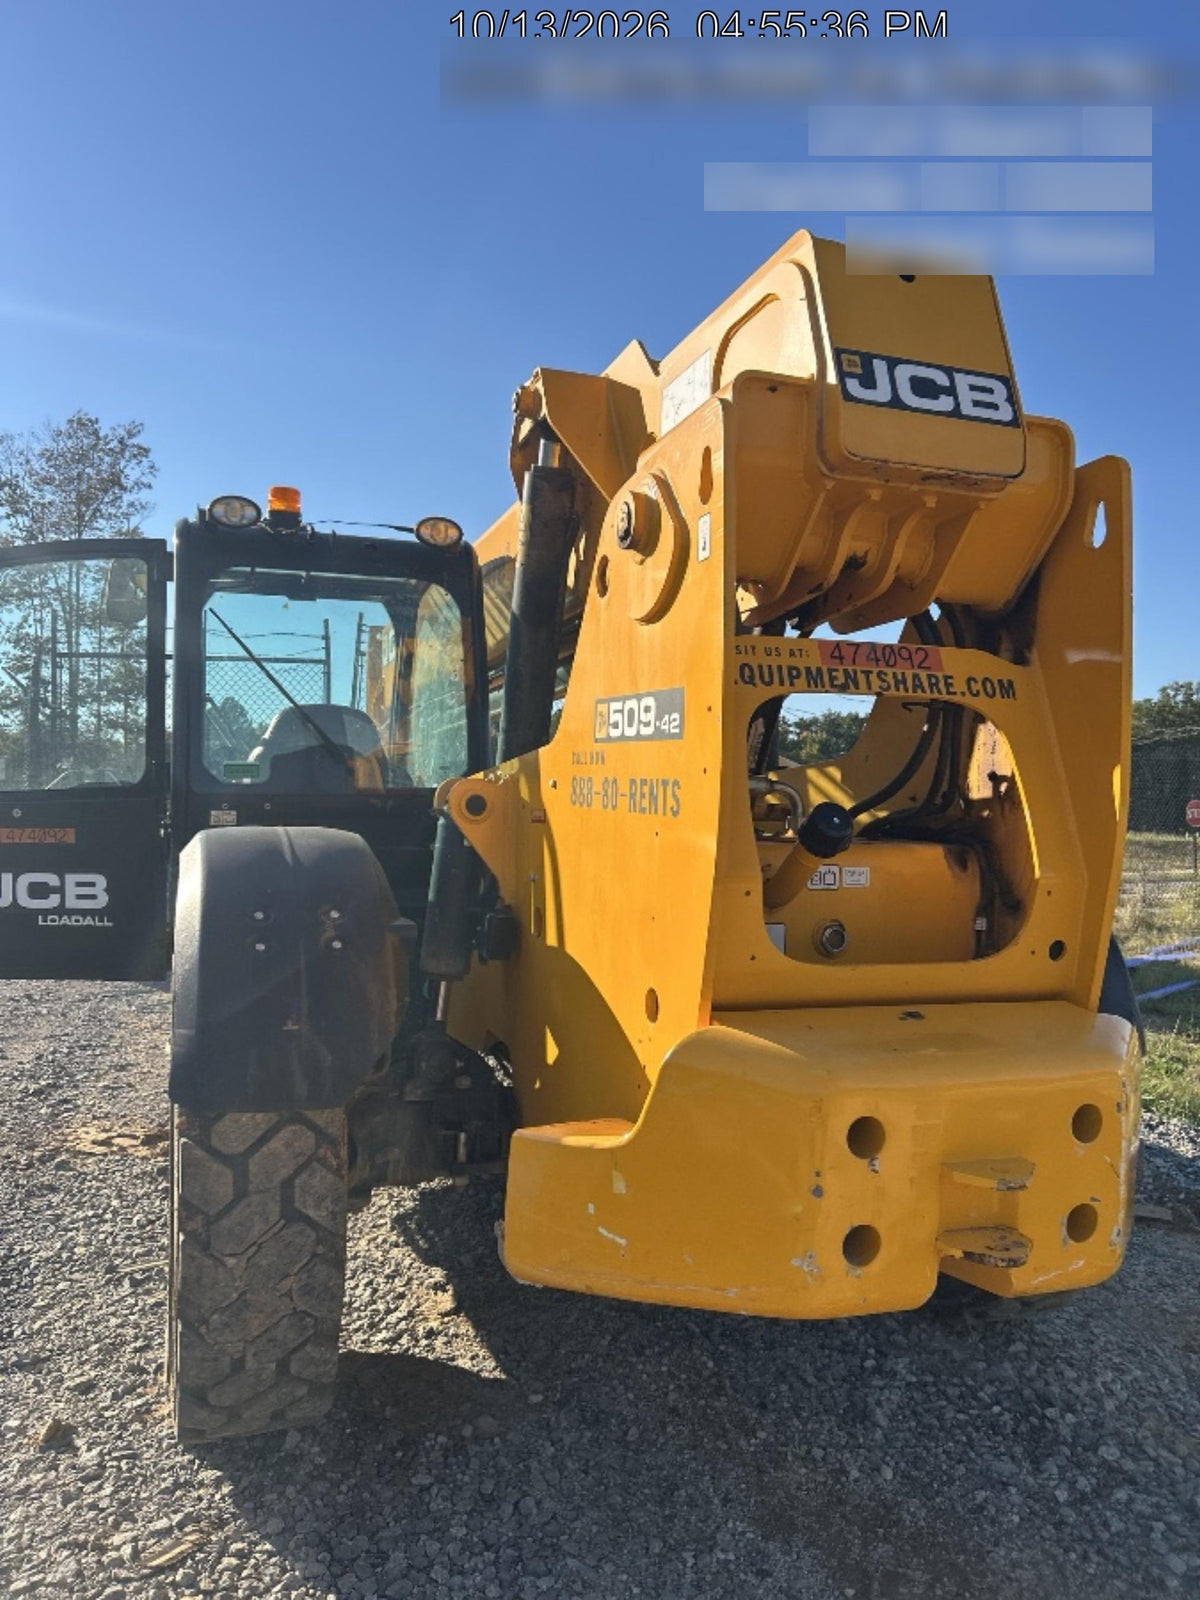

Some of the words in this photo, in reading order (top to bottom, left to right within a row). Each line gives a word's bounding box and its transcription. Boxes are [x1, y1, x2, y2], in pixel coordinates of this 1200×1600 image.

[844, 358, 1015, 423] JCB
[764, 646, 781, 657] US
[829, 642, 933, 670] 474092
[734, 662, 1017, 701] QUIPMENTSHARE.COM
[570, 775, 681, 818] 888-80-RENTS
[38, 914, 113, 927] LOADALL
